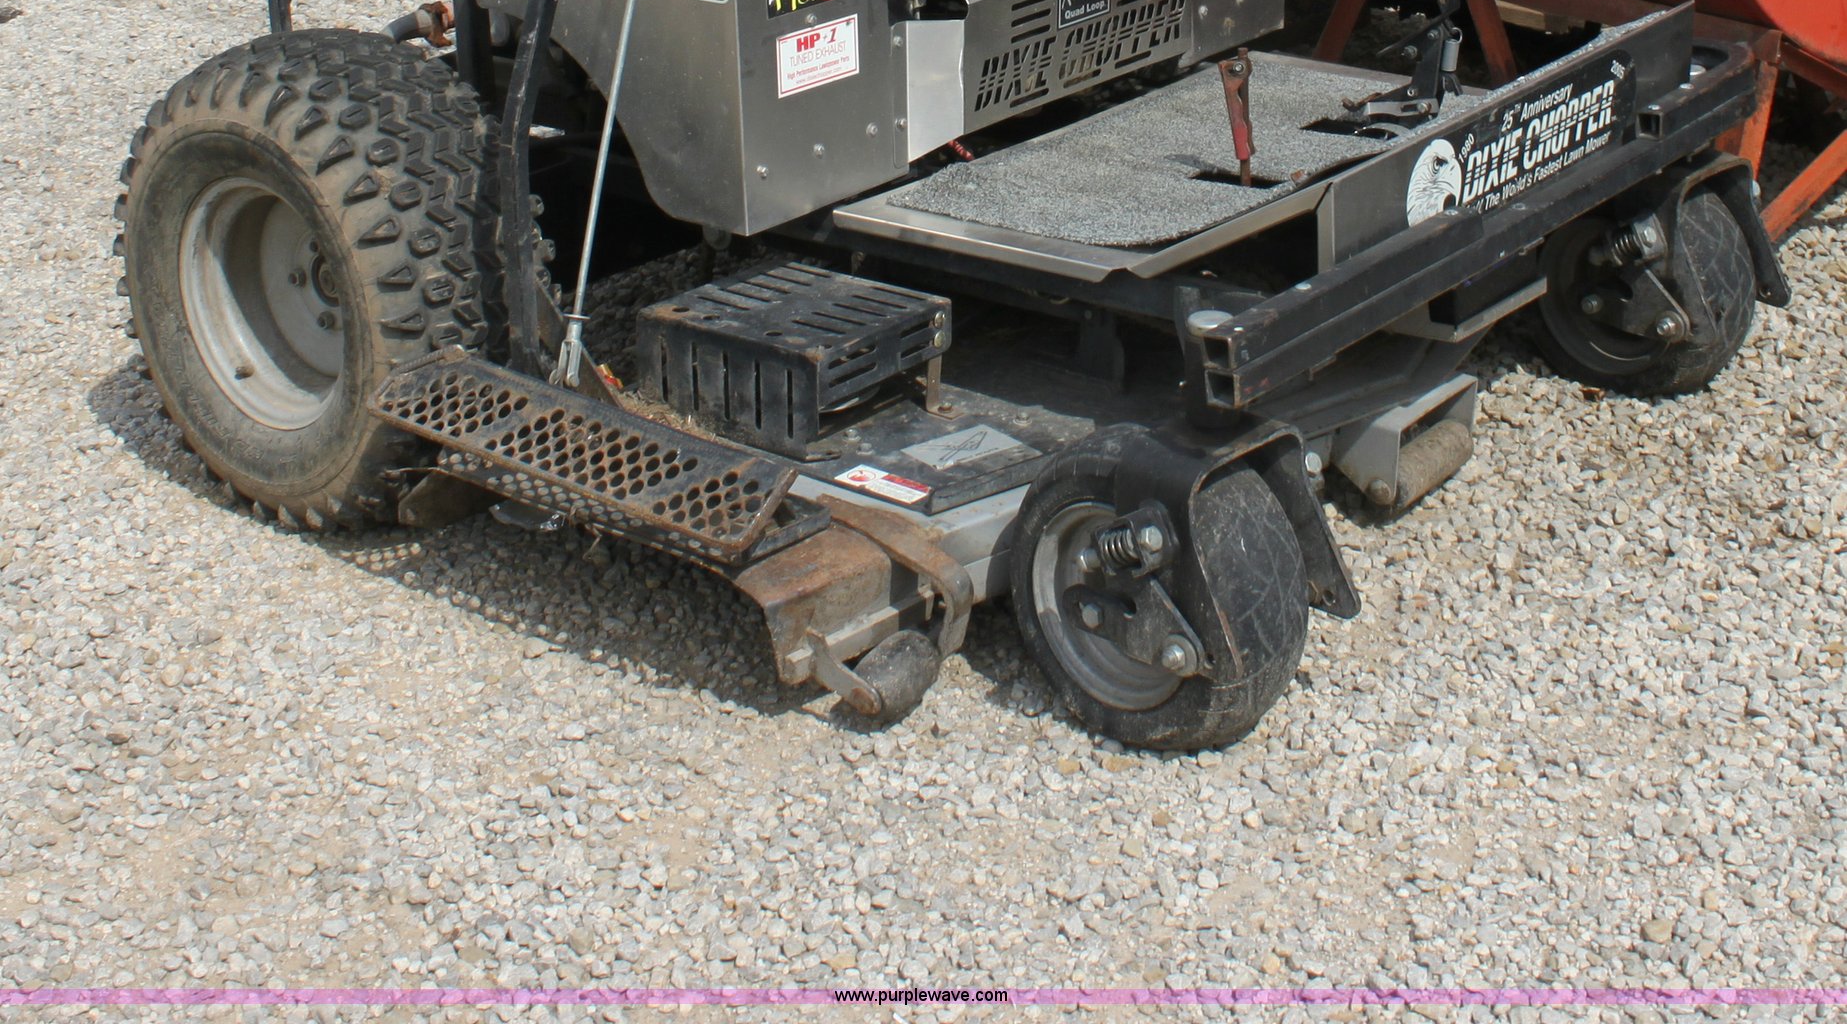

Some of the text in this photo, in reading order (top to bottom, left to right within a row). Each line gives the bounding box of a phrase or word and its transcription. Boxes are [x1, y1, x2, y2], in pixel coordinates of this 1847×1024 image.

[1064, 0, 1105, 20] Quad Loop
[789, 40, 847, 68] TUNED EXHAUST
[796, 32, 820, 53] HP
[1520, 82, 1574, 123] Anniversary
[1458, 132, 1474, 164] 1980
[1462, 79, 1616, 206] DIXIE CHOPPER
[1485, 191, 1501, 211] The
[1502, 172, 1533, 201] World's
[1533, 154, 1563, 184] Fastest
[1563, 145, 1585, 167] Lawn
[1585, 129, 1613, 155] Mower
